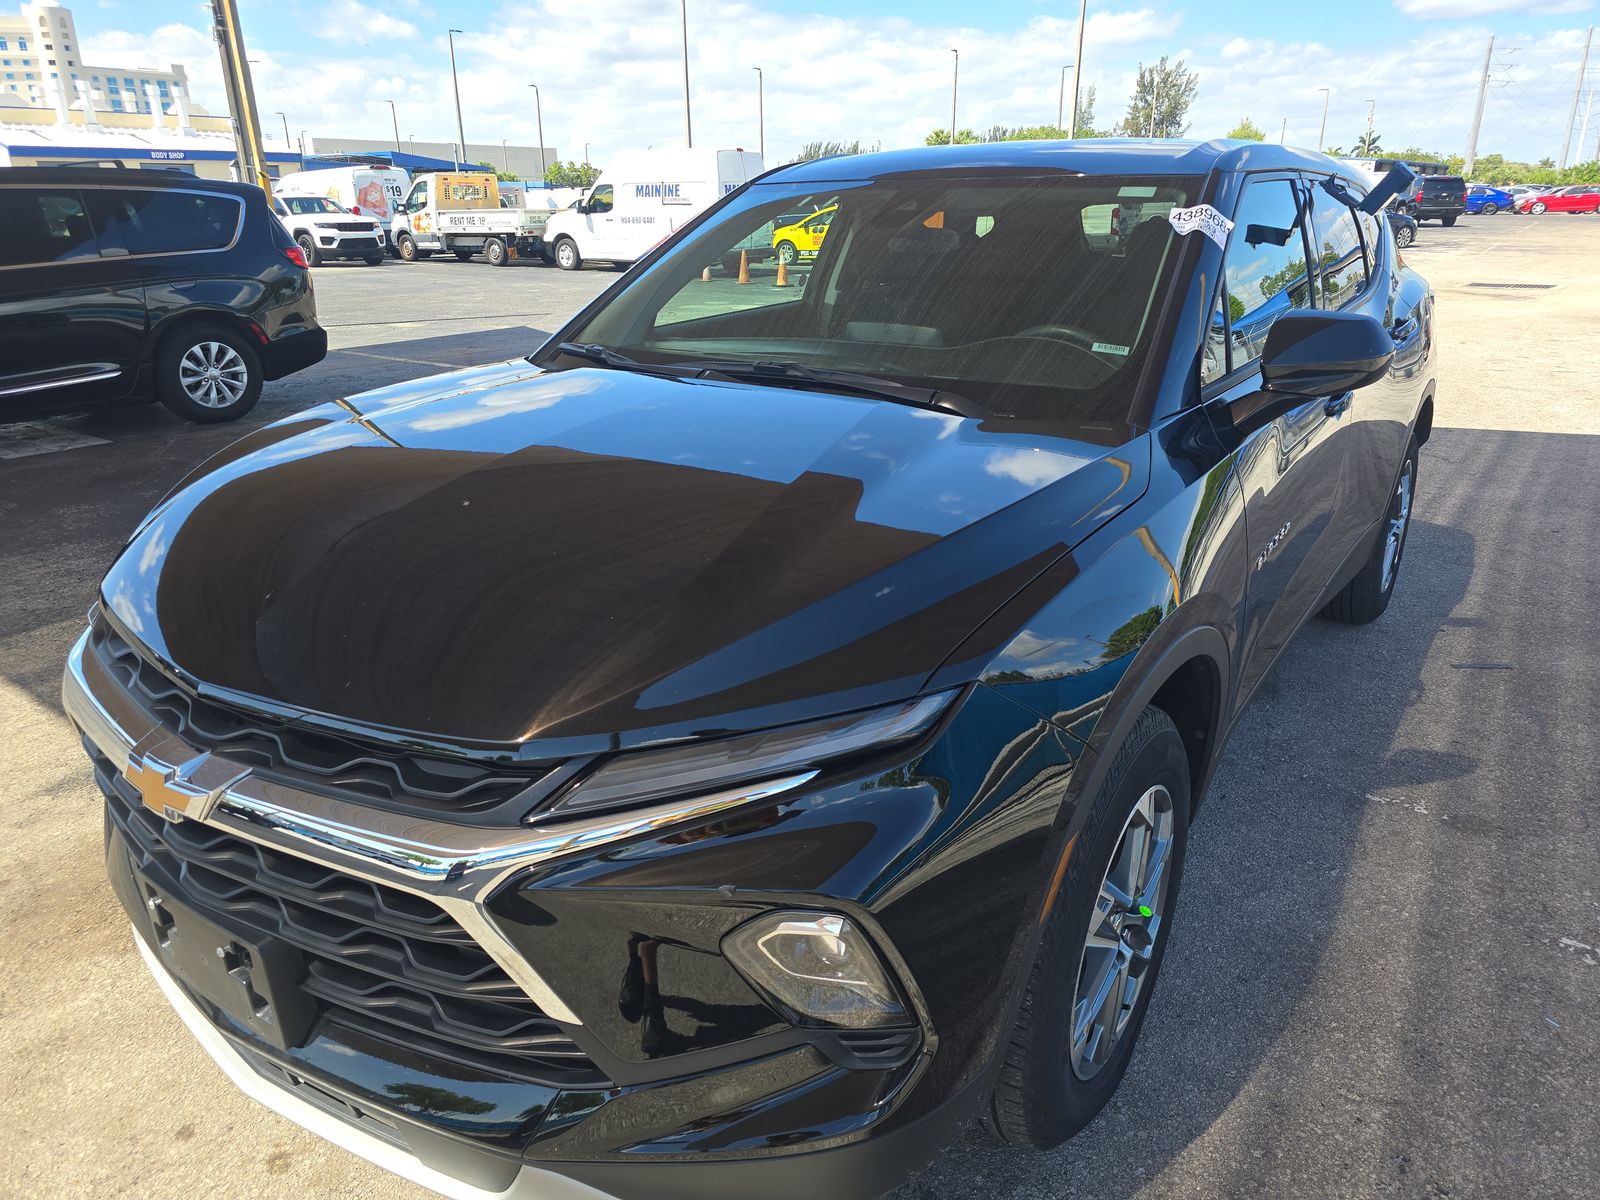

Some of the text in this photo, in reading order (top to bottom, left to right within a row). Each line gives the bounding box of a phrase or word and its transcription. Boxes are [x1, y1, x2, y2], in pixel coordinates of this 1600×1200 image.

[150, 151, 185, 160] BODY SHOP
[385, 185, 402, 197] $19
[449, 216, 465, 226] RENT
